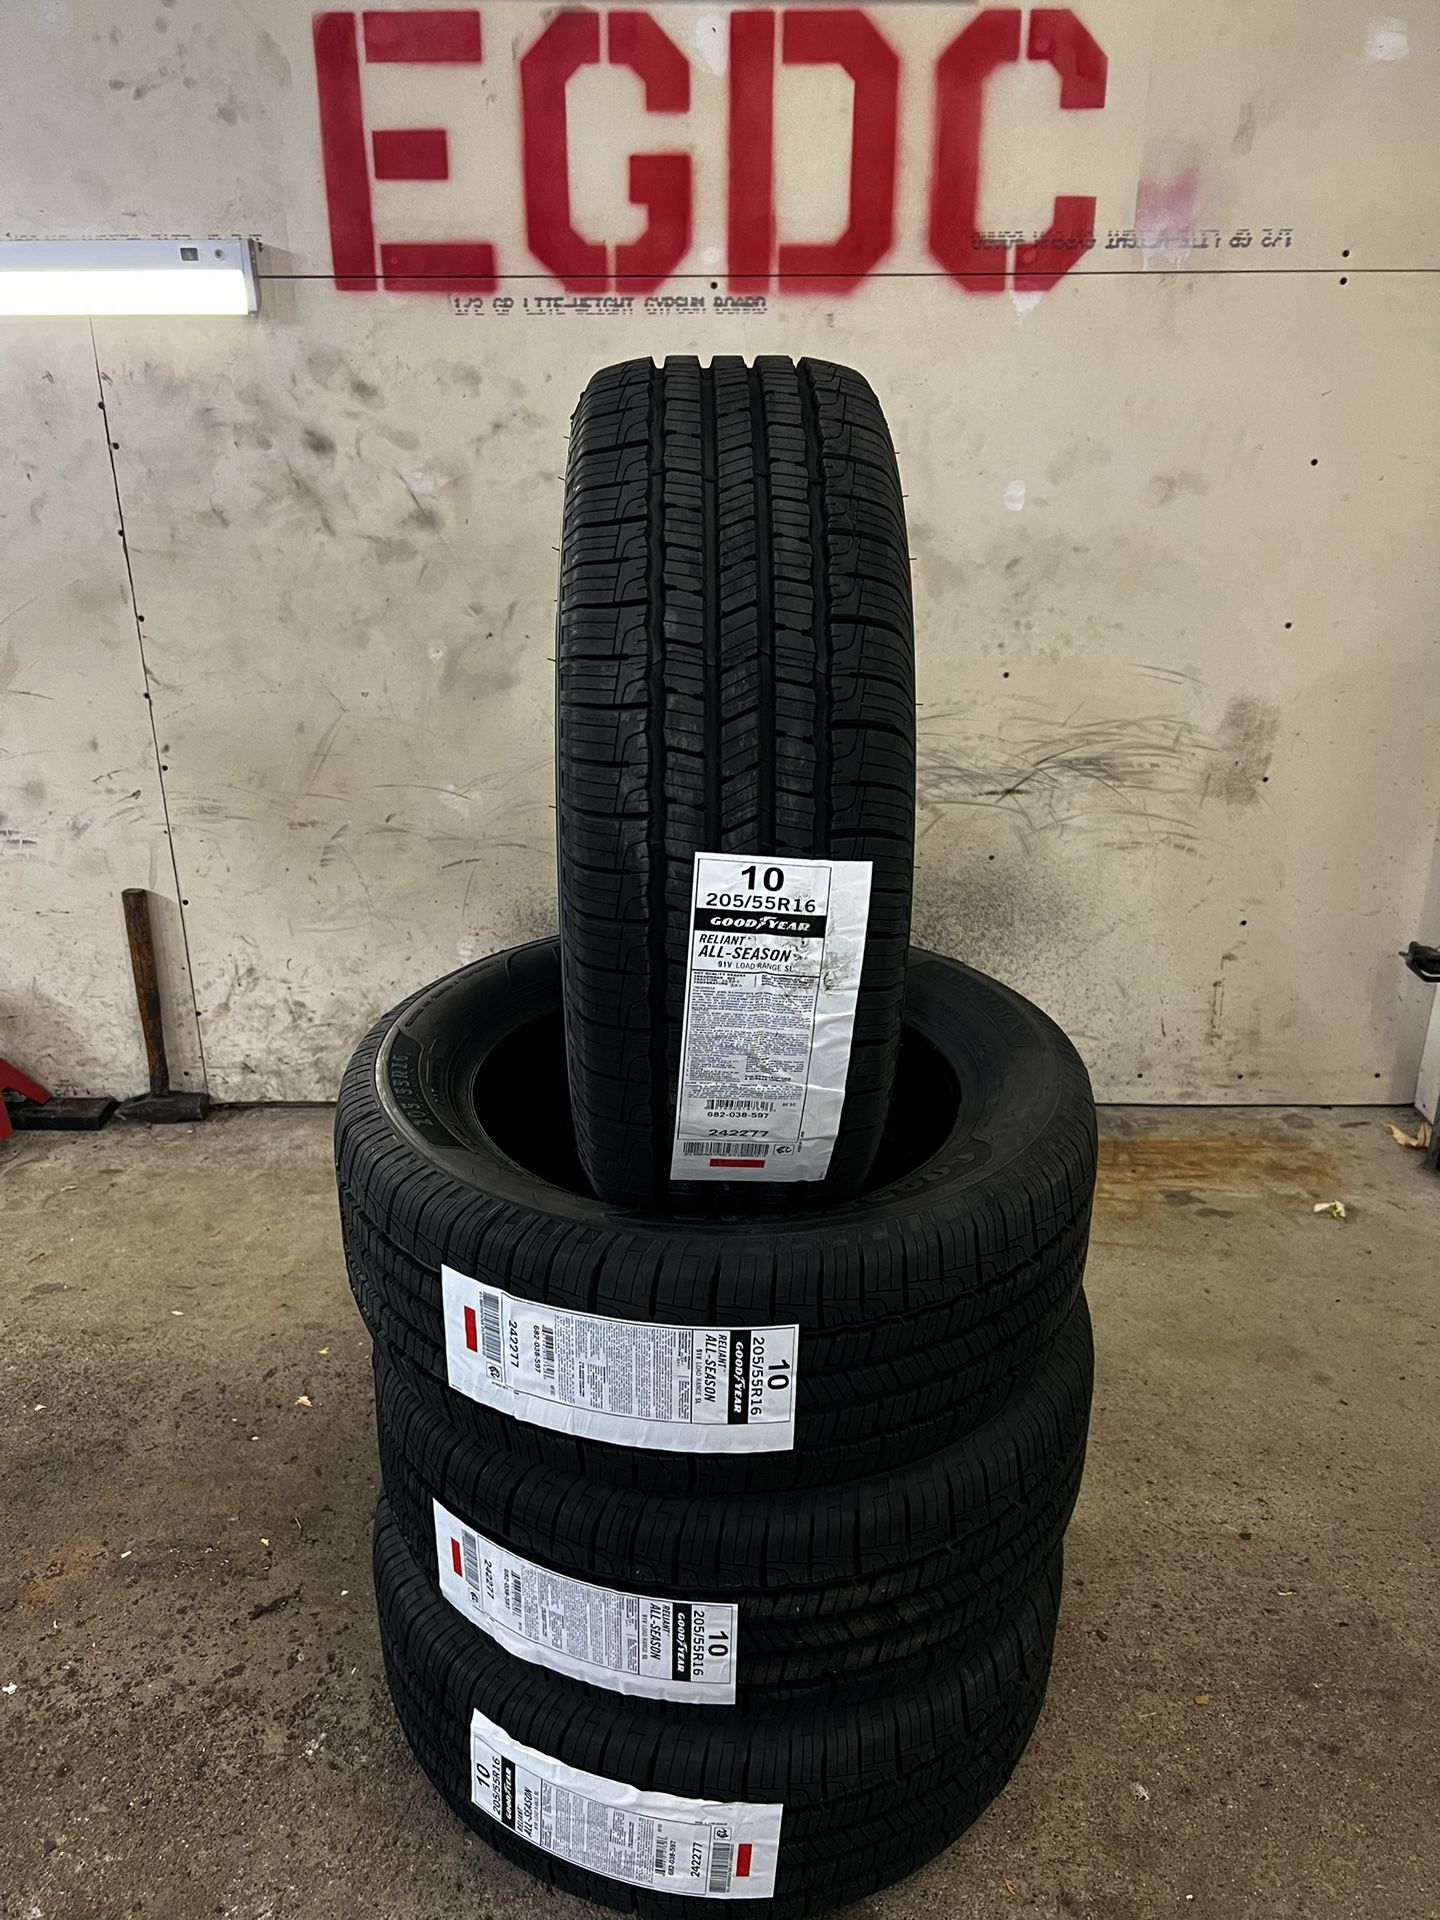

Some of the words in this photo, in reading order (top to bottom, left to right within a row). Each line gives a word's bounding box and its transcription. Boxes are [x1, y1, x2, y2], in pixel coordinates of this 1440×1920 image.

[313, 8, 1109, 293] EGDC
[741, 866, 784, 891] 10
[706, 893, 815, 912] 205/55R16
[698, 945, 792, 963] ALL-SEASON
[699, 934, 746, 945] RELIANT
[709, 1129, 769, 1137] 242277
[509, 1320, 519, 1368] 242277
[533, 1325, 541, 1373] 682-038-597
[718, 1335, 727, 1368] RELIANT
[705, 1334, 717, 1402] ALL-SEASON
[751, 1337, 765, 1415] 205/55R16
[767, 1359, 790, 1390] 10
[485, 1559, 494, 1600] 242277
[650, 1603, 661, 1660] ALL-SEASON
[693, 1610, 704, 1676] 205/55R16
[708, 1631, 729, 1657] 10
[476, 1763, 490, 1787] 10
[492, 1756, 501, 1815] 205/55R16
[524, 1787, 533, 1837] ALL-SEASON
[690, 1842, 703, 1877] 242277
